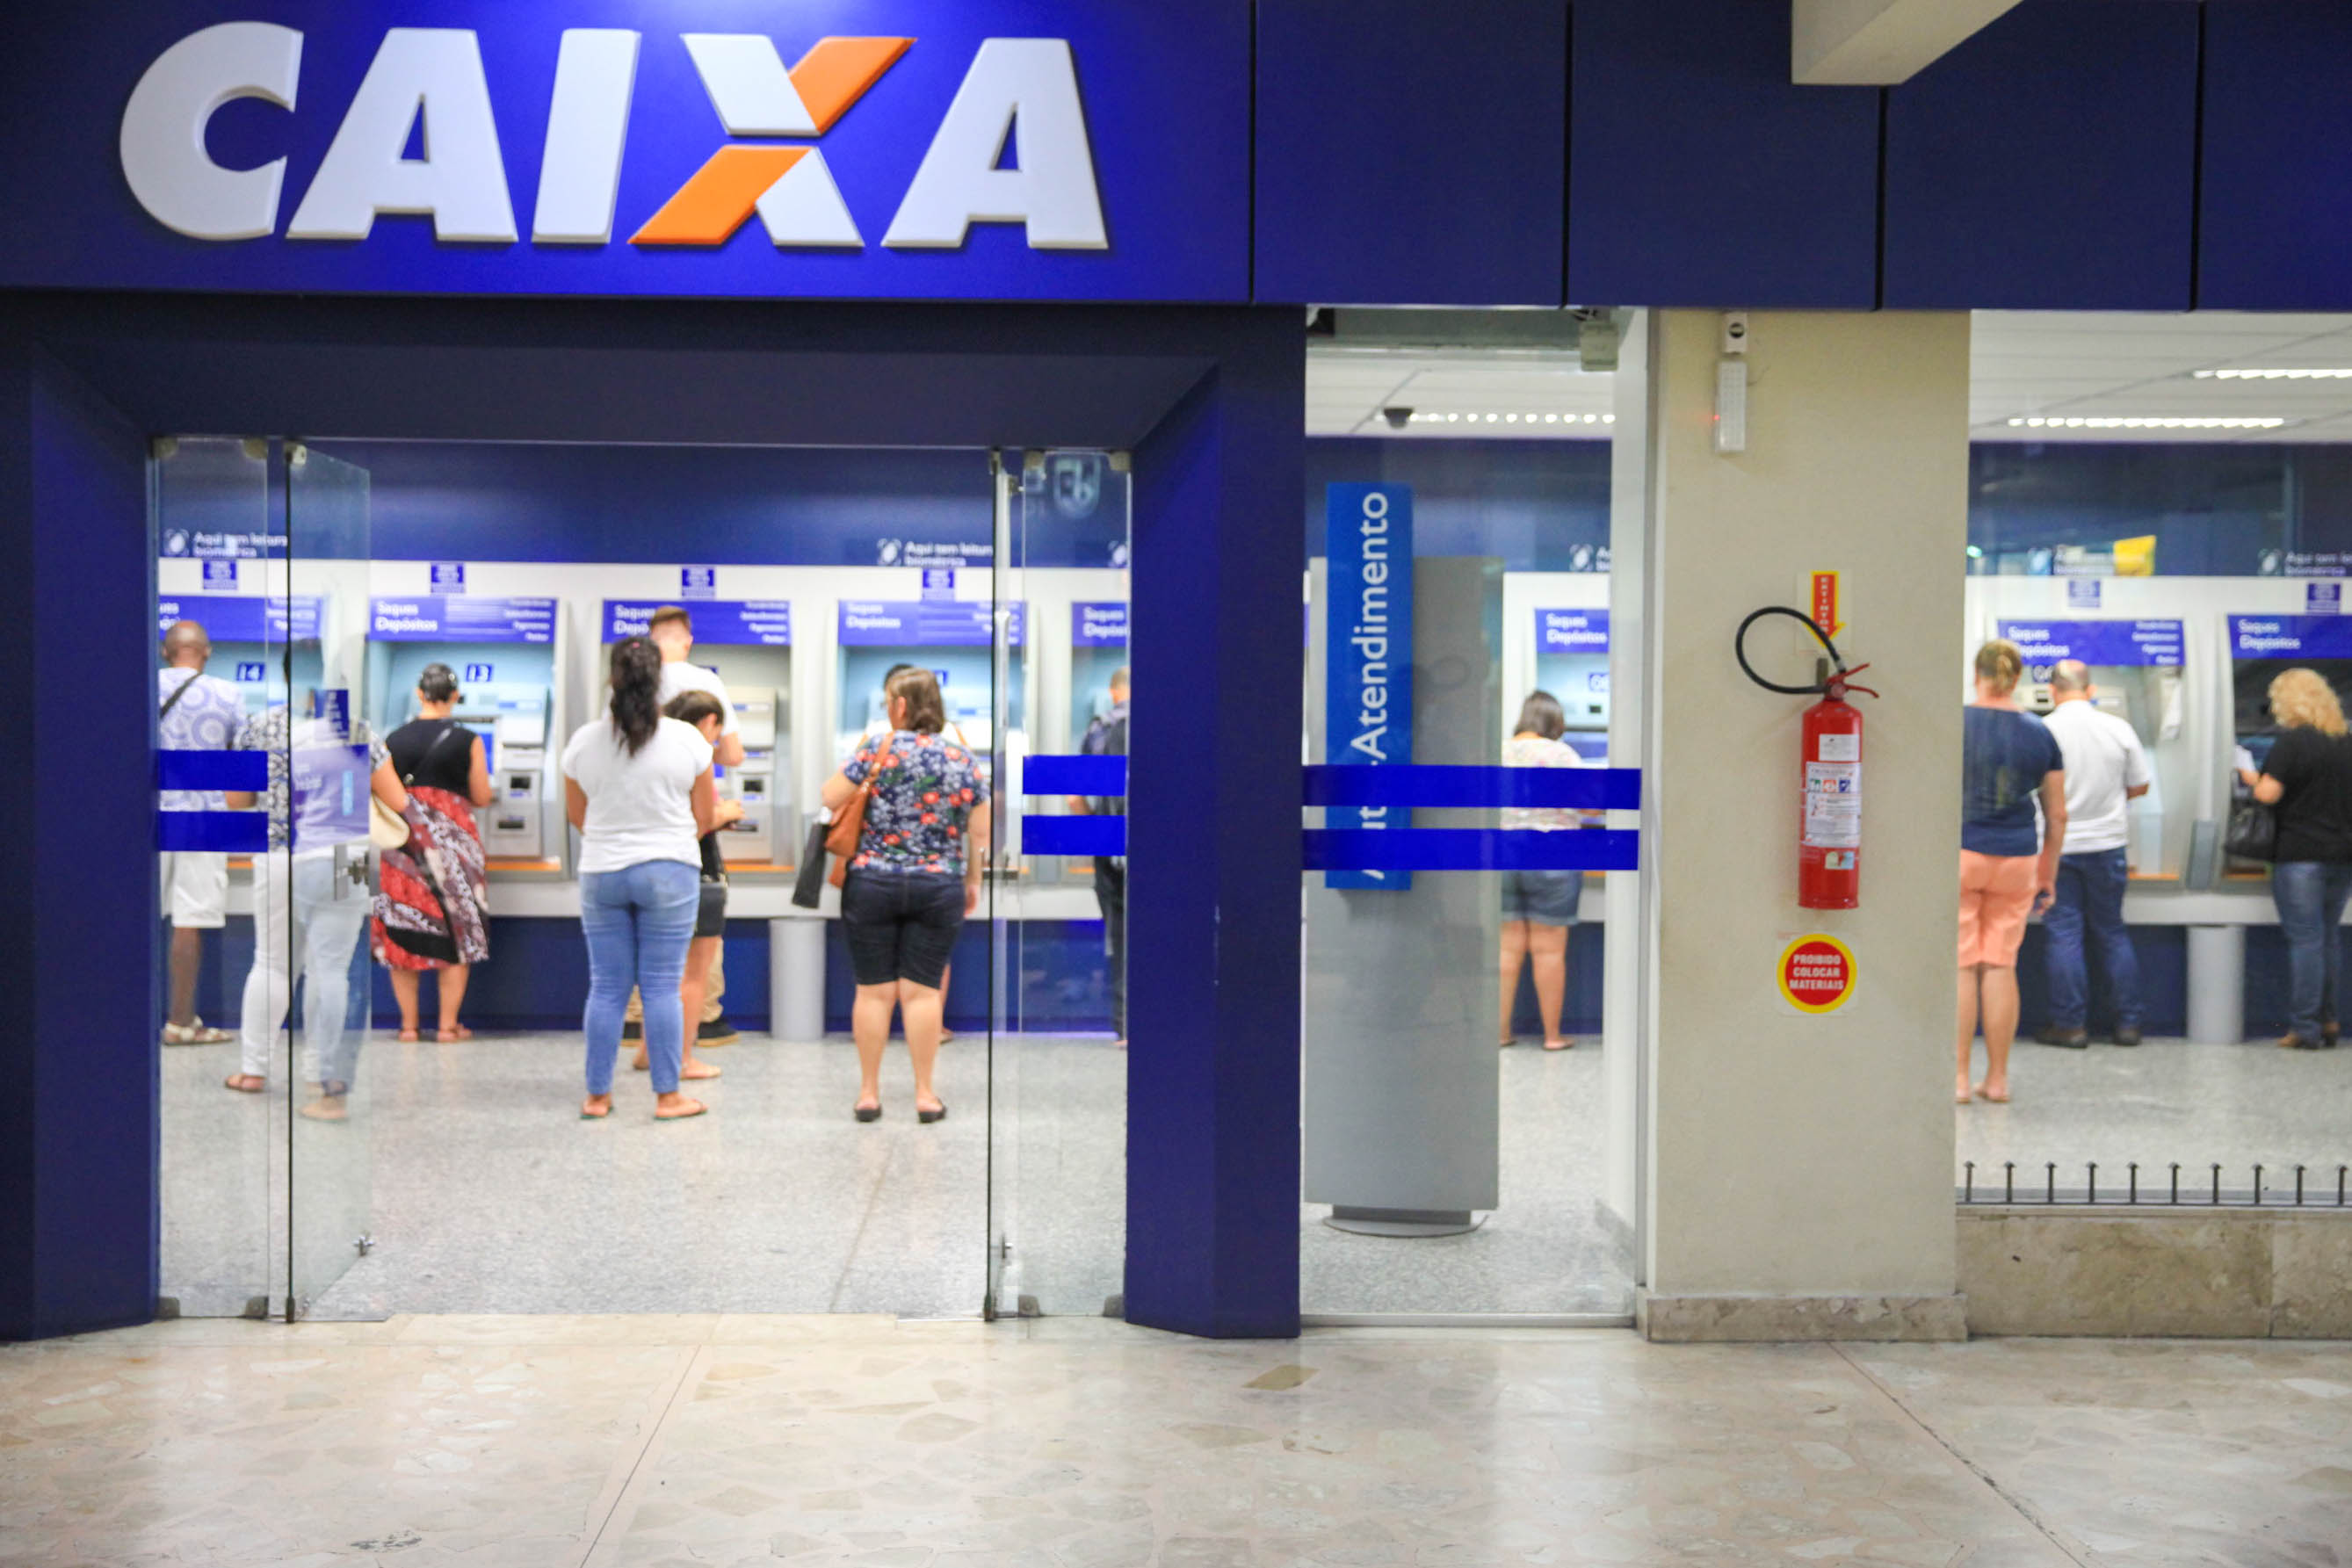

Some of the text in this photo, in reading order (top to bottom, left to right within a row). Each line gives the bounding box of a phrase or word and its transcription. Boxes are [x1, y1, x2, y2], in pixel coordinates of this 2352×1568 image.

[119, 20, 1108, 249] CAIXA
[240, 663, 261, 681] 14
[1793, 954, 1842, 965] PROIBIDO
[1793, 967, 1841, 977] COLOCAR
[1789, 979, 1844, 990] MATERIAIS
